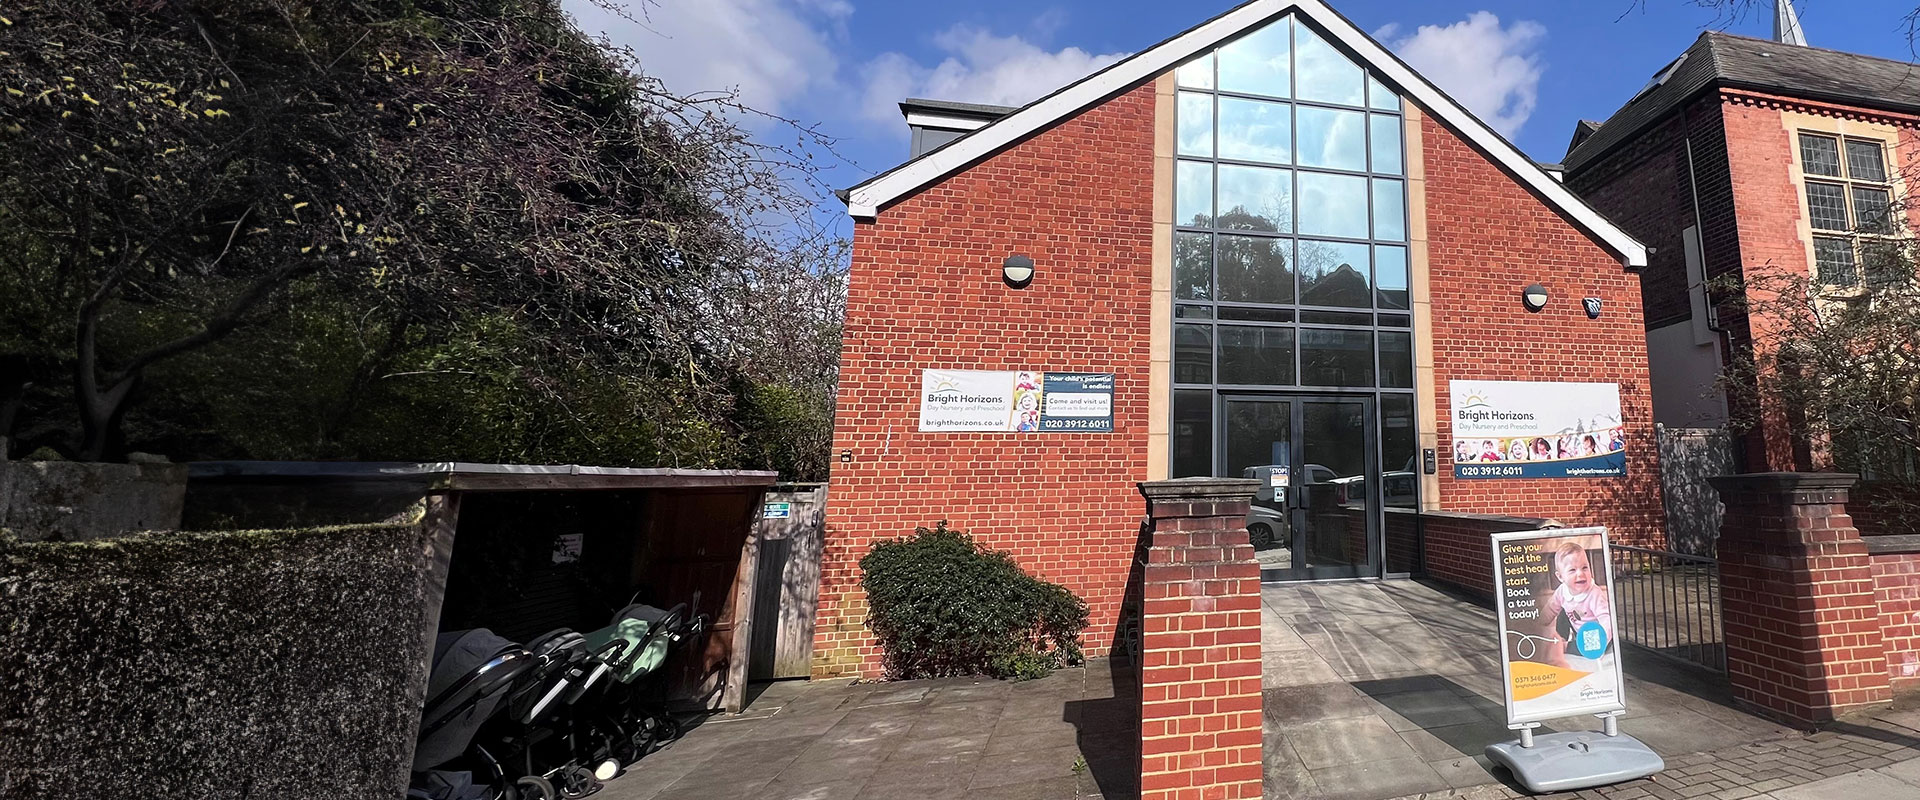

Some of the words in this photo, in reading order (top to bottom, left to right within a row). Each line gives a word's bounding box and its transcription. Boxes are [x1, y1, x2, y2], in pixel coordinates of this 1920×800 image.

[928, 394, 958, 404] Bright
[960, 395, 1003, 403] Horizons
[1459, 410, 1490, 422] Bright
[1492, 410, 1534, 420] Horizons
[1046, 420, 1062, 428] 020
[1065, 420, 1087, 428] 3912
[1089, 420, 1110, 428] 6011
[1459, 423, 1471, 431] Day
[1473, 423, 1496, 431] Nursery
[1462, 467, 1478, 475] 020
[1480, 467, 1501, 475] 3912
[1503, 466, 1522, 475] 6011
[1502, 545, 1522, 554] Give
[1523, 544, 1542, 554] your
[1503, 555, 1524, 564] child
[1526, 554, 1541, 562] the
[1504, 566, 1524, 575] best
[1526, 564, 1548, 573] head
[1505, 577, 1530, 586] start.
[1507, 587, 1530, 597] Book
[1516, 599, 1535, 607] tour
[1508, 609, 1539, 619] today!
